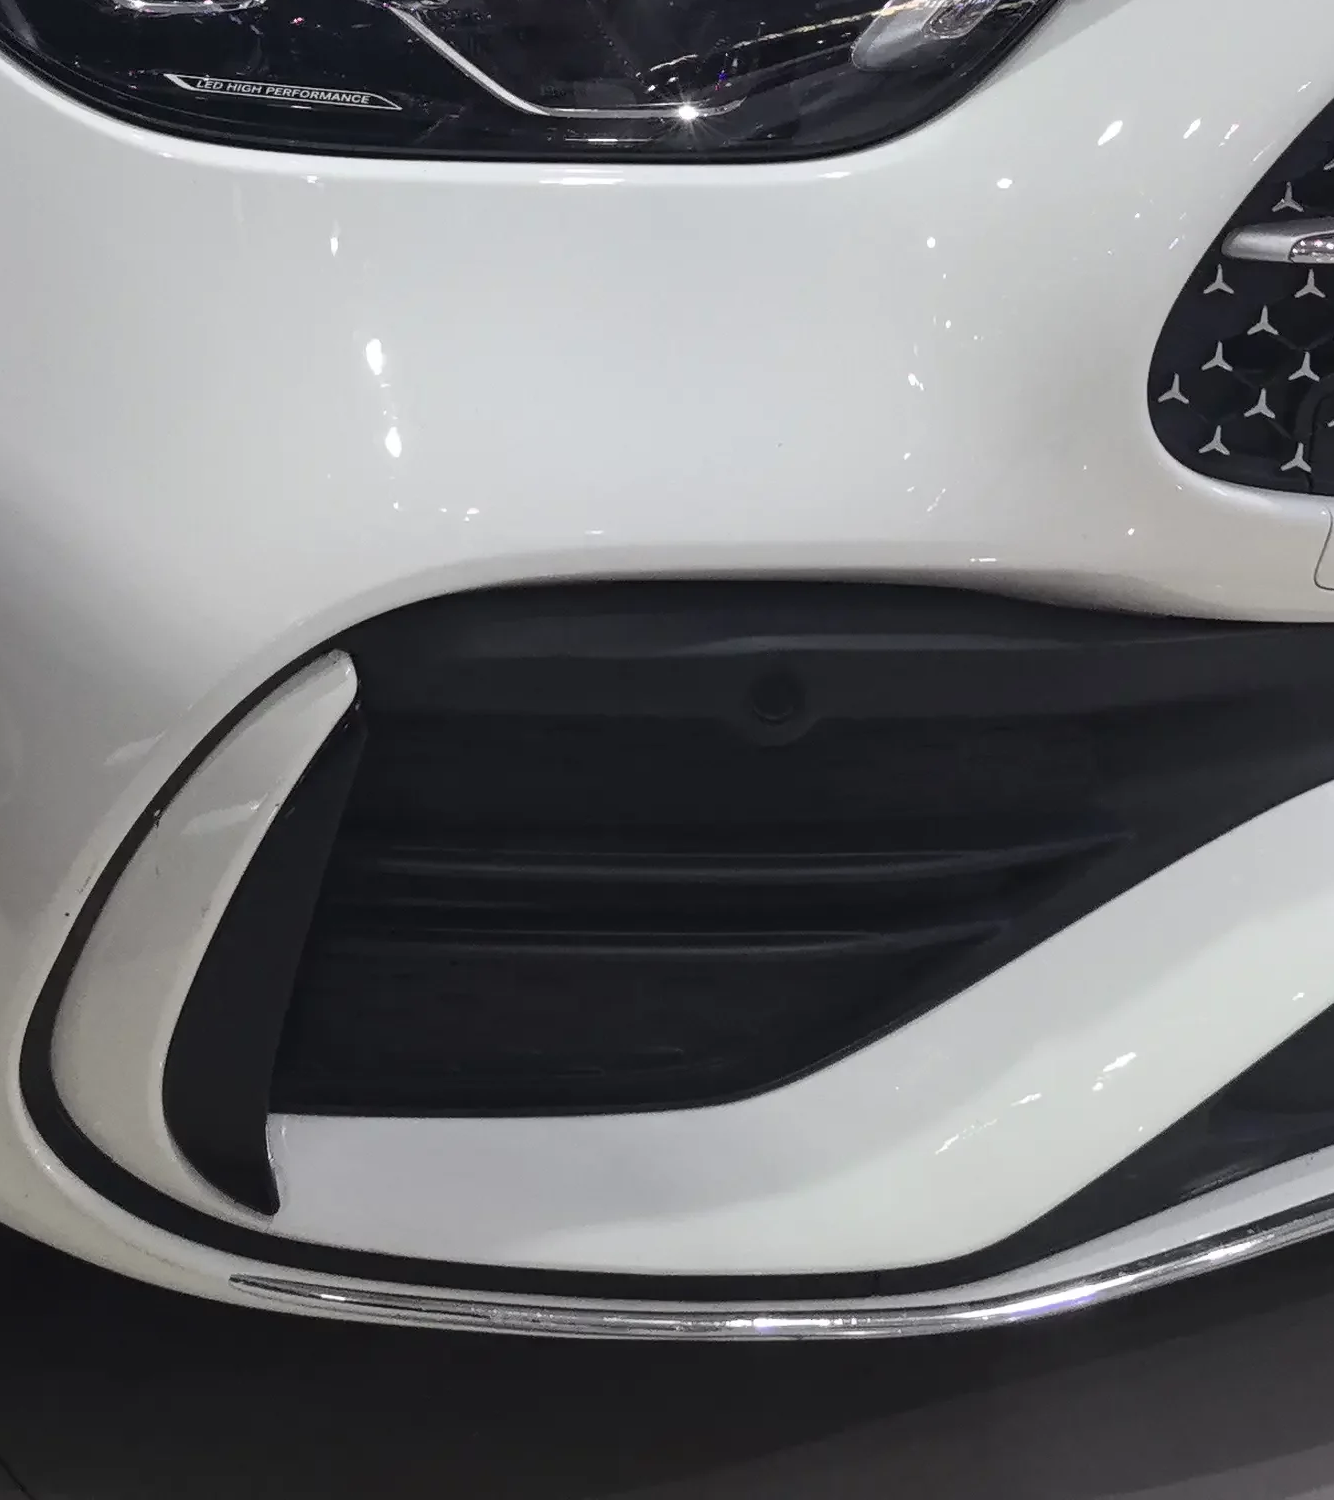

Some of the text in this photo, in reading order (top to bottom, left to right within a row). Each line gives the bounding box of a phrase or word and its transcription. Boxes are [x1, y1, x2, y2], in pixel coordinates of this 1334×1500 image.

[196, 79, 371, 104] LED HIGH PERFORMANCE
